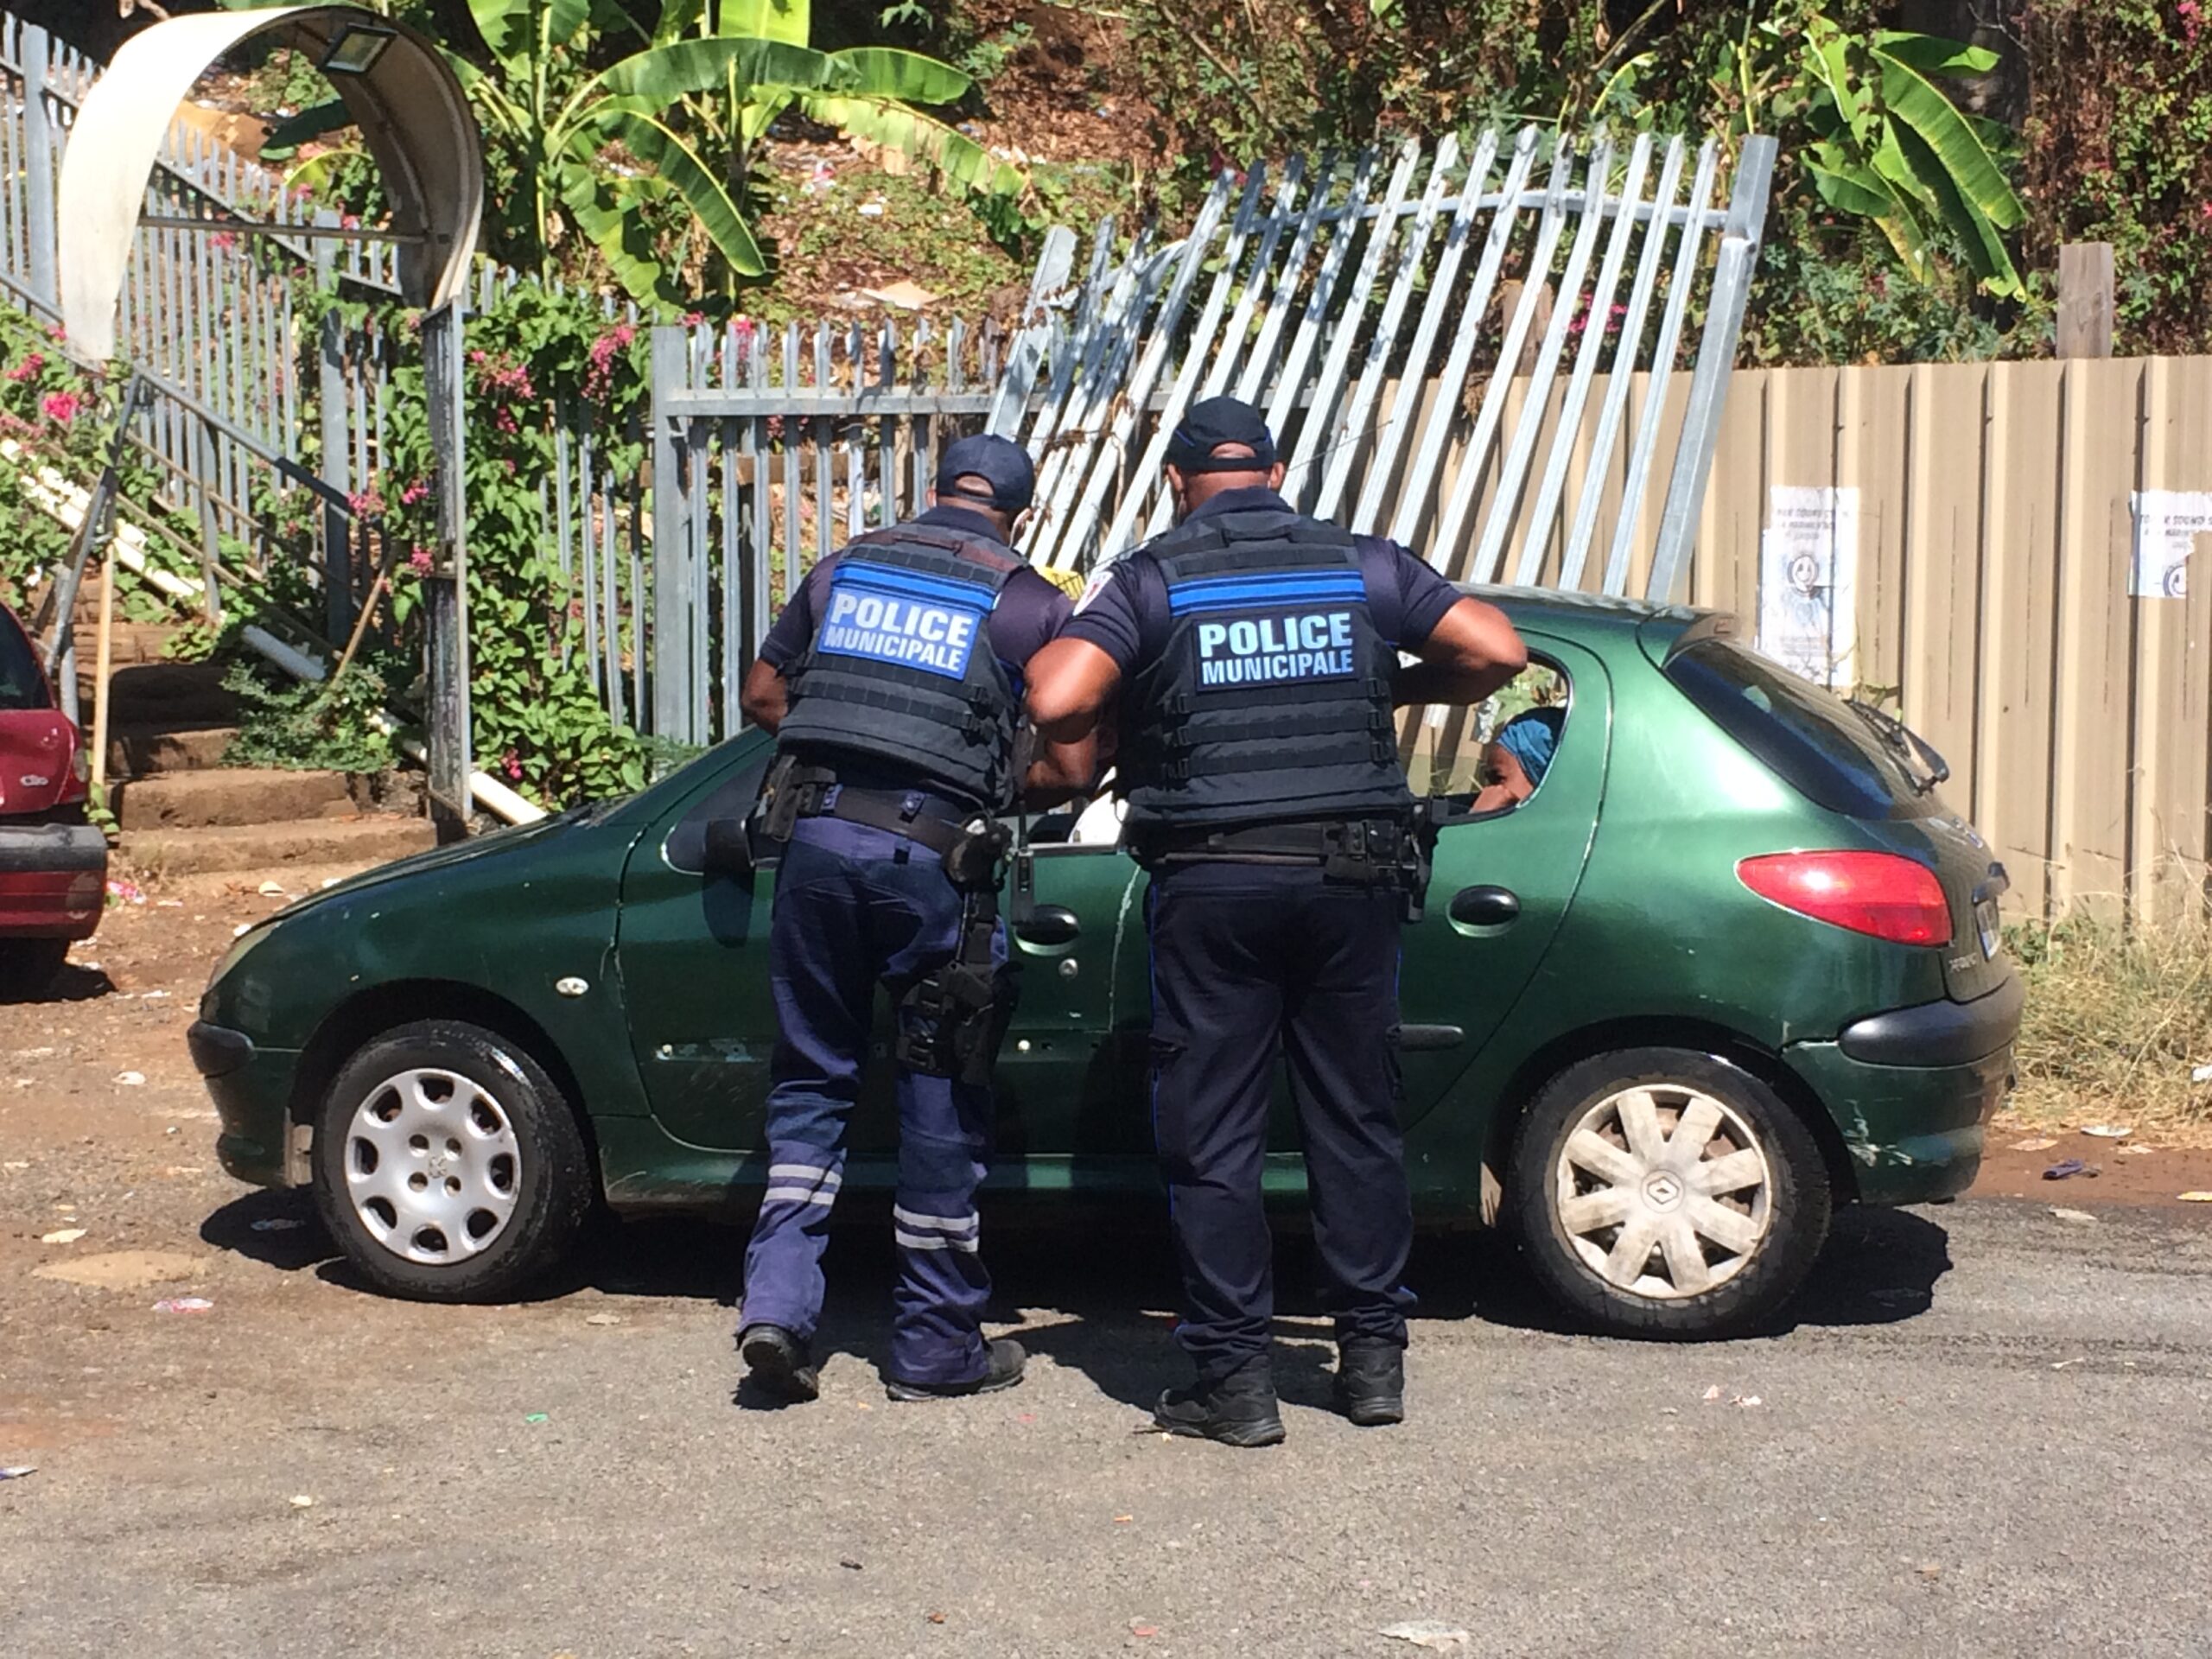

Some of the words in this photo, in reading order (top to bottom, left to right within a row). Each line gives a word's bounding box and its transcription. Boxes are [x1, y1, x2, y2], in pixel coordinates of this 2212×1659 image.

[830, 593, 973, 648] POLICE
[1198, 613, 1353, 658] POLICE
[823, 625, 963, 672] MUNICIPALE
[1202, 649, 1354, 685] MUNICIPALE
